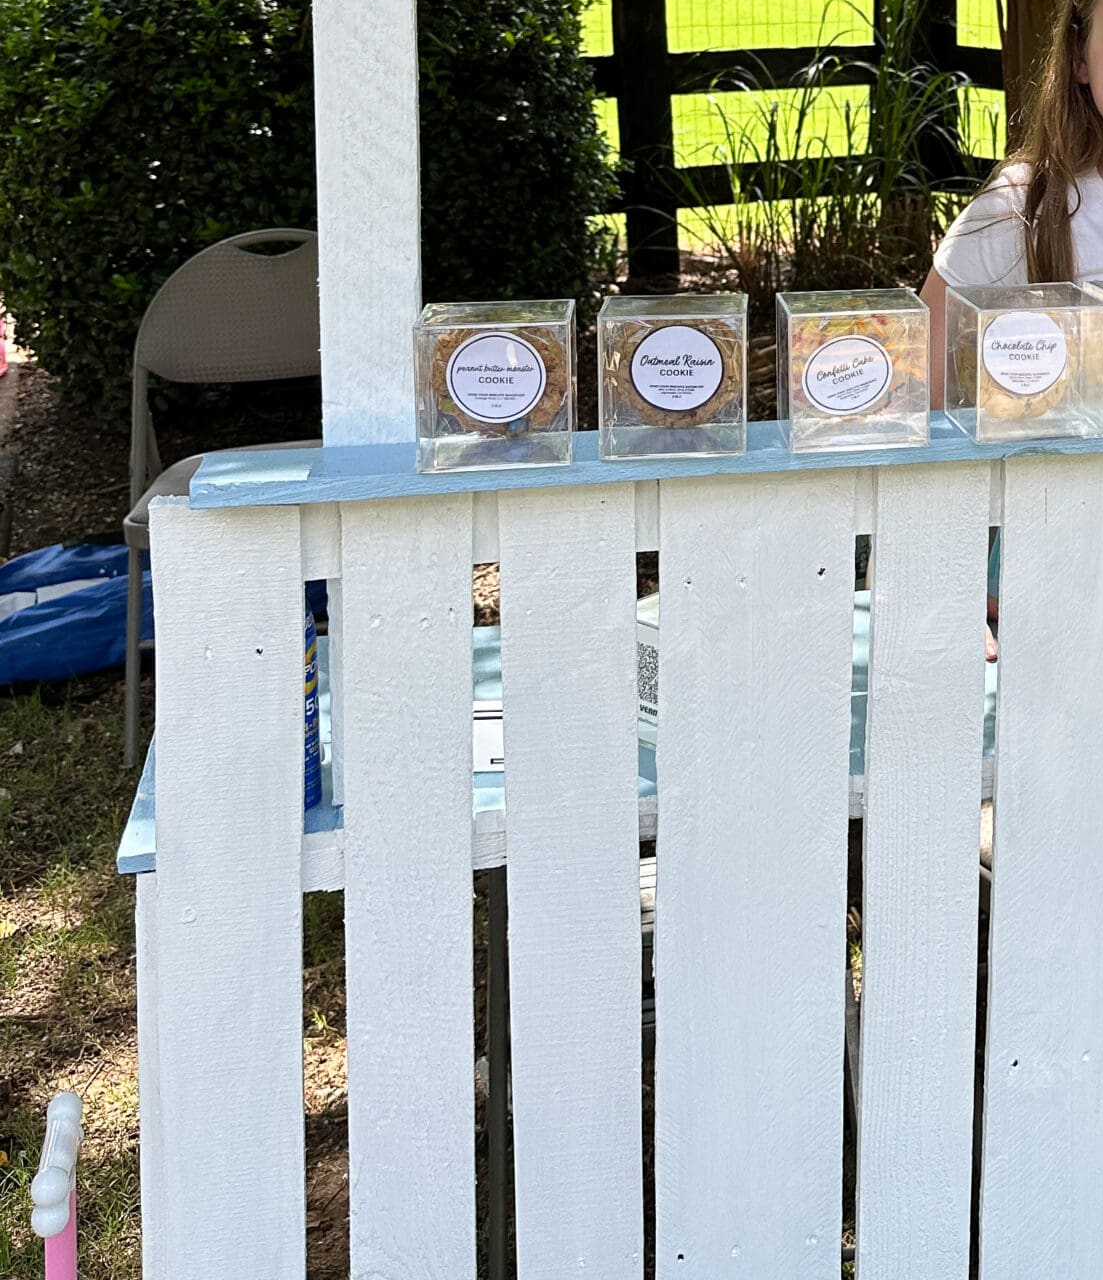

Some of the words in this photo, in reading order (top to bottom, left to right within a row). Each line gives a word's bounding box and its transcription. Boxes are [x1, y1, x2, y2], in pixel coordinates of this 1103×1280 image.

[991, 340, 1034, 351] Chocolate
[1036, 339, 1057, 352] Chip
[640, 354, 681, 366] Oatmeal
[682, 354, 715, 368] Raisin
[1009, 353, 1040, 361] COOKIE
[456, 364, 482, 374] peanut
[484, 363, 505, 373] butter
[816, 364, 851, 381] Confetti
[852, 355, 874, 369] Cake
[478, 376, 514, 384] COOKIE
[832, 368, 865, 385] COOKIE
